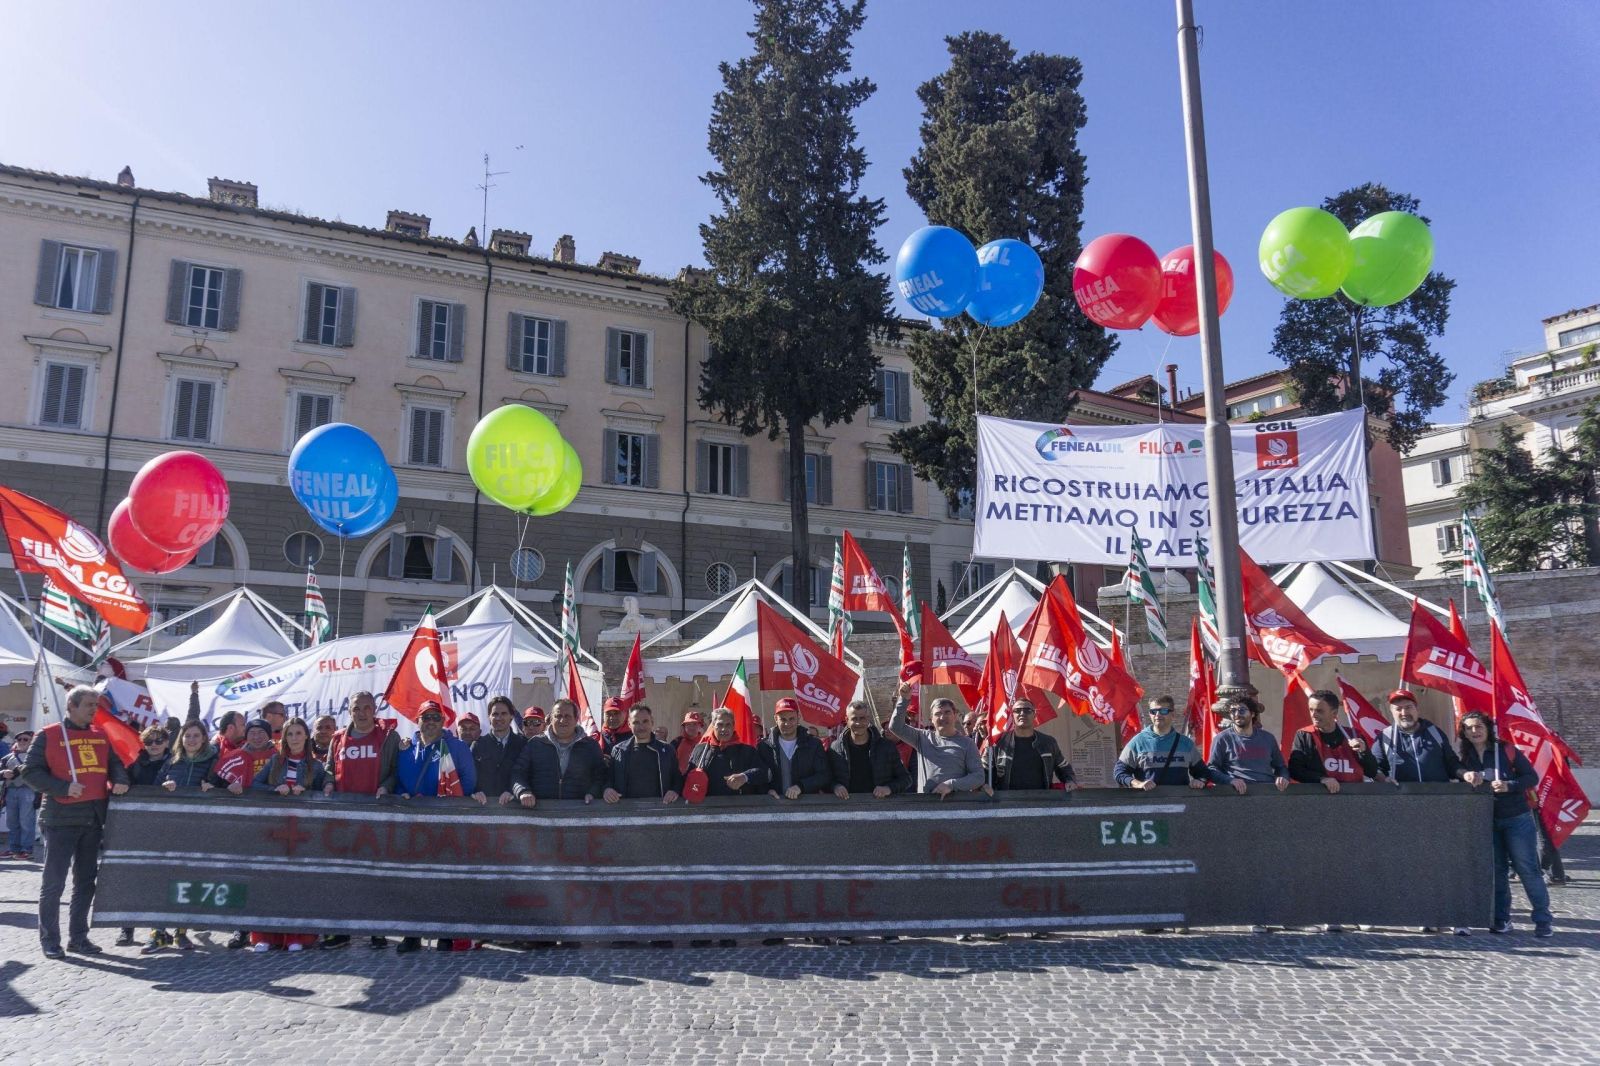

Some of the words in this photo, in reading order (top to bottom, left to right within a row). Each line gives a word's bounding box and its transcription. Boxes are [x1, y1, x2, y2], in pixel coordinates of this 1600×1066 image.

[1256, 422, 1297, 432] CGIL
[1139, 441, 1185, 454] FILCA
[1263, 459, 1294, 467] FILLEA
[294, 469, 376, 498] FENEAL
[313, 499, 357, 519] UIL
[986, 501, 1138, 527] METTIAMO
[1150, 511, 1177, 528] IN
[1190, 501, 1358, 528] SIUREZZA
[1106, 537, 1126, 555] IL
[1140, 538, 1209, 557] PAES
[319, 656, 362, 673] FILCA
[803, 682, 841, 711] CGIL
[321, 820, 615, 864] CALDARELLE
[564, 879, 875, 922] PASSERELLE
